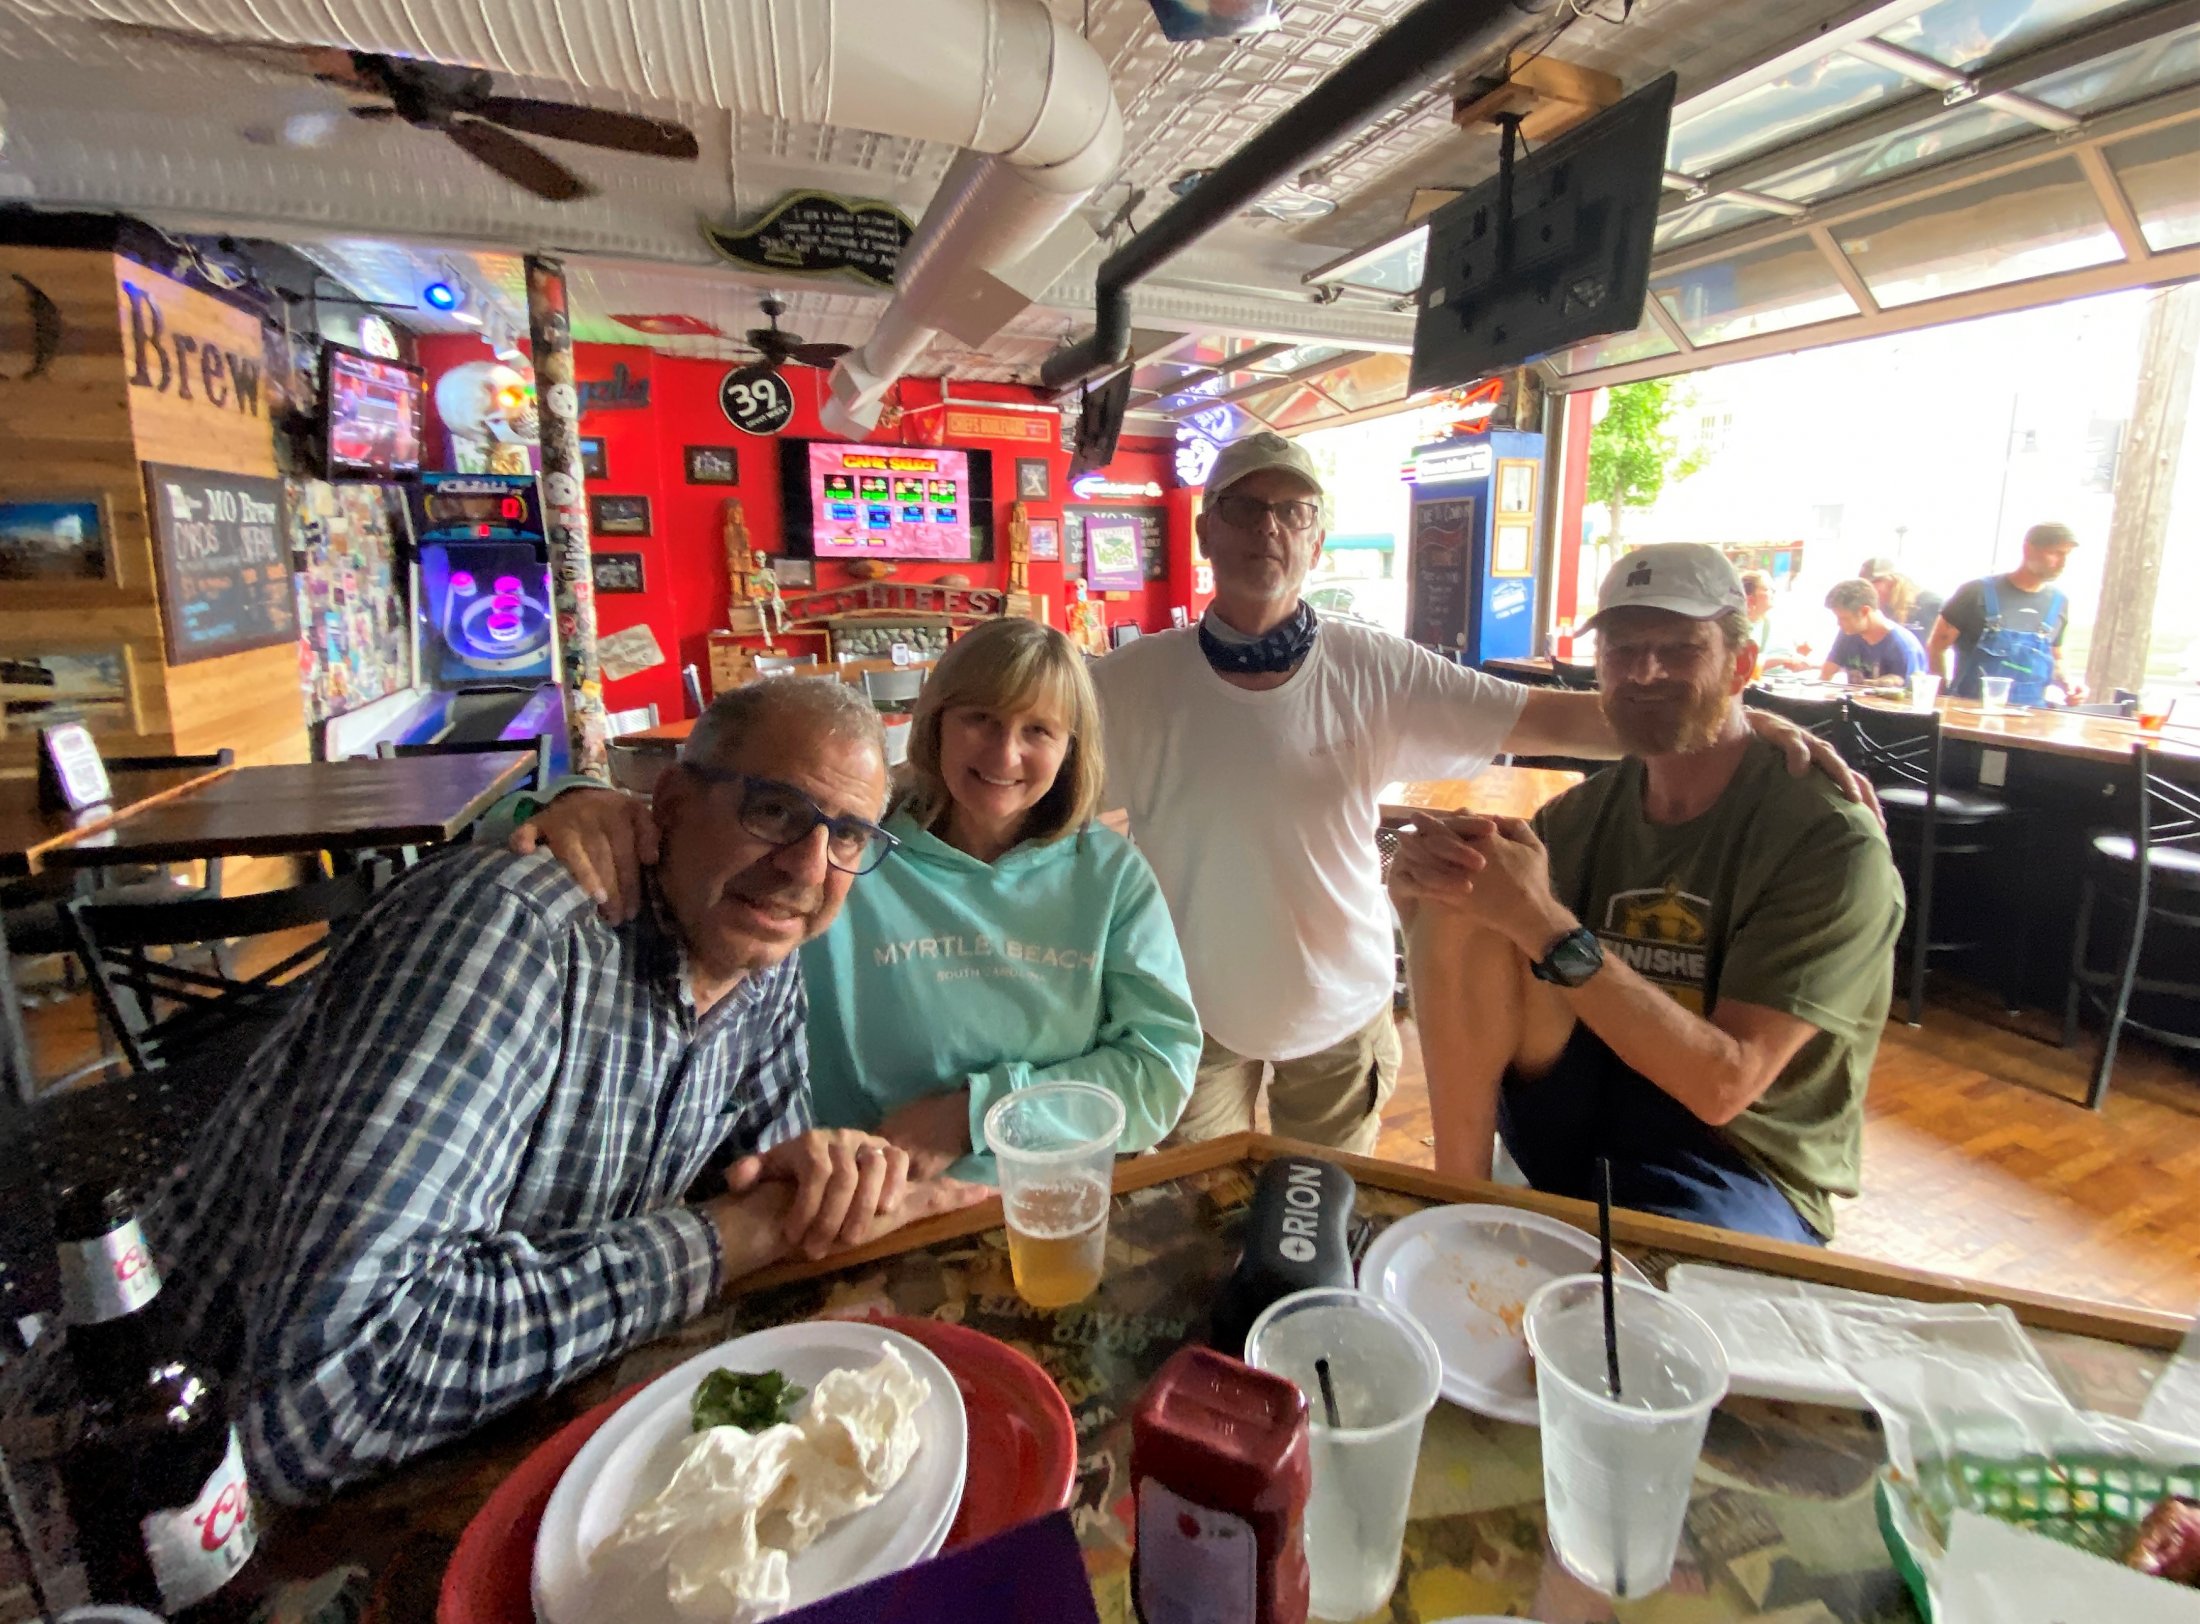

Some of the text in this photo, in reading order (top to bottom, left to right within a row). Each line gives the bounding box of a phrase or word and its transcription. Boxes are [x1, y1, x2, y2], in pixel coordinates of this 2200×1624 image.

[122, 280, 262, 417] Brew
[728, 379, 777, 417] 39
[843, 455, 938, 473] GAME SELECT
[873, 934, 1098, 971] MYRTLE BEACH
[1600, 940, 1707, 979] INISHE
[1279, 1163, 1322, 1262] ORION
